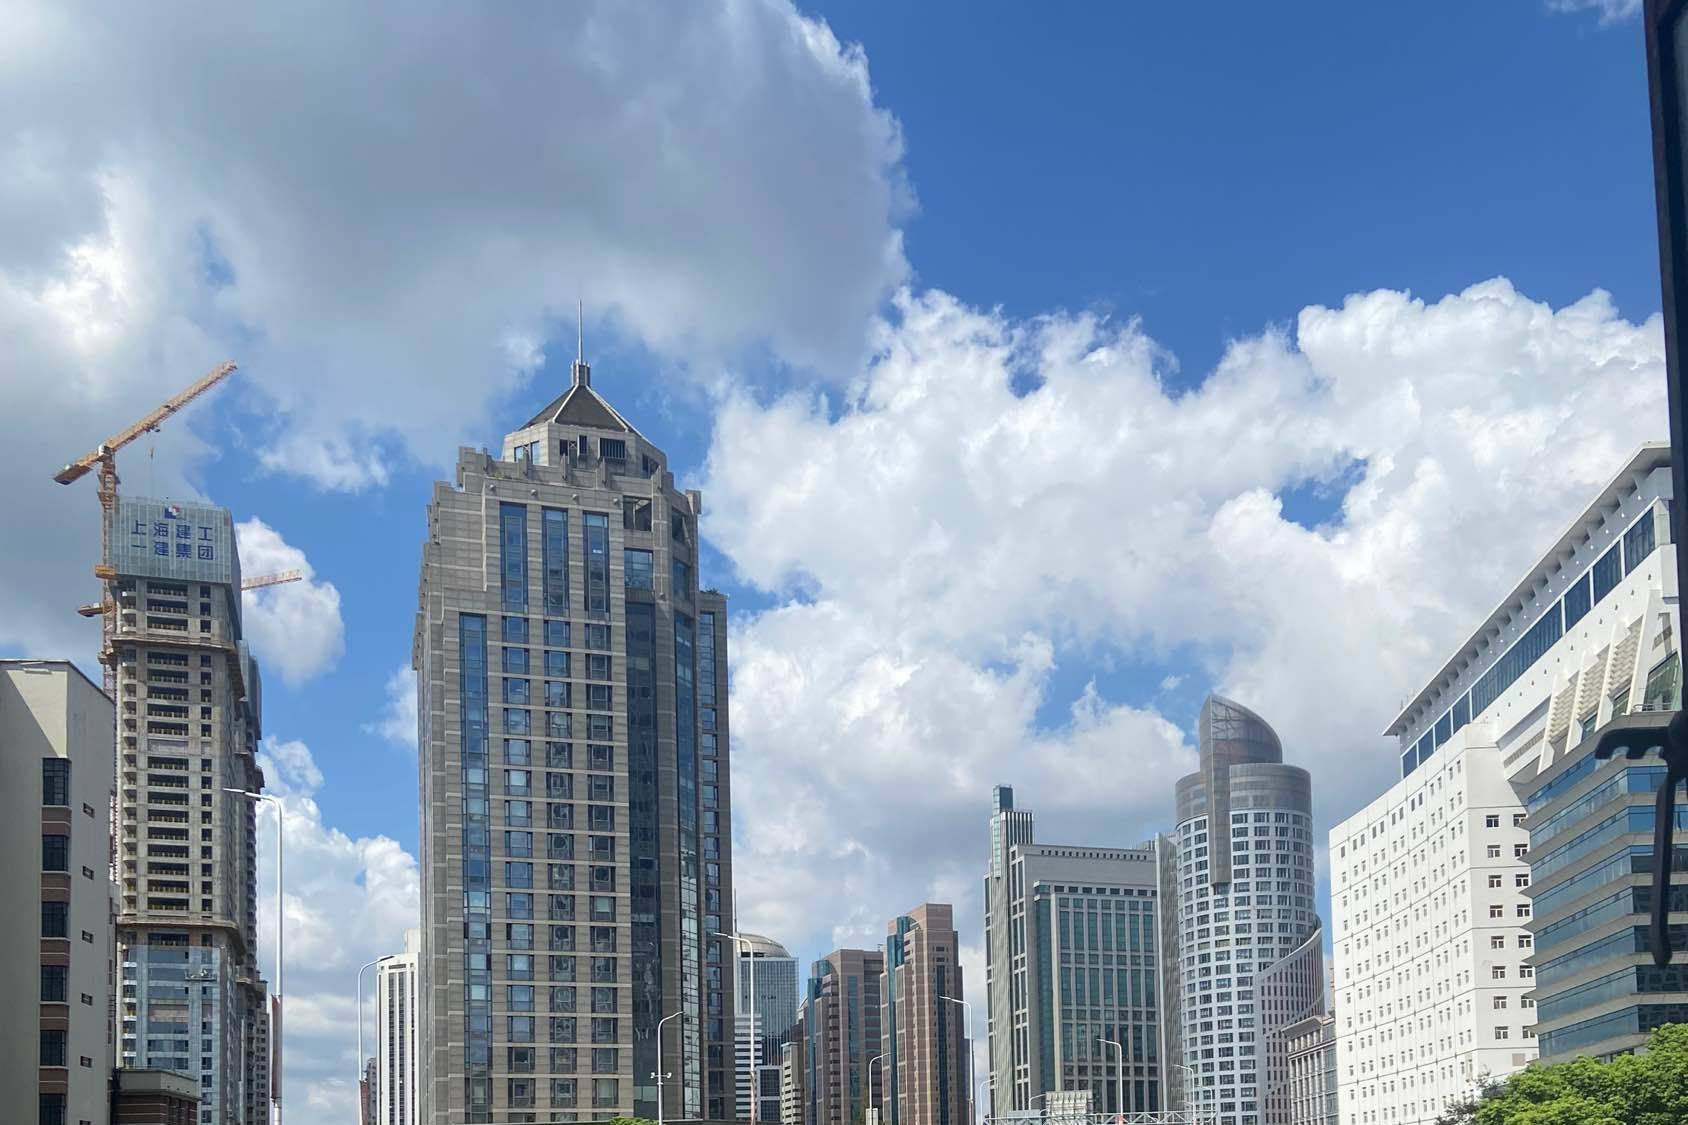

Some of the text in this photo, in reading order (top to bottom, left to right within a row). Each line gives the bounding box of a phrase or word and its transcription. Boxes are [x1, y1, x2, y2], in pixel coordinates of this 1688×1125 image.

[131, 520, 213, 541] 上海建工
[131, 541, 214, 561] 一建集团
